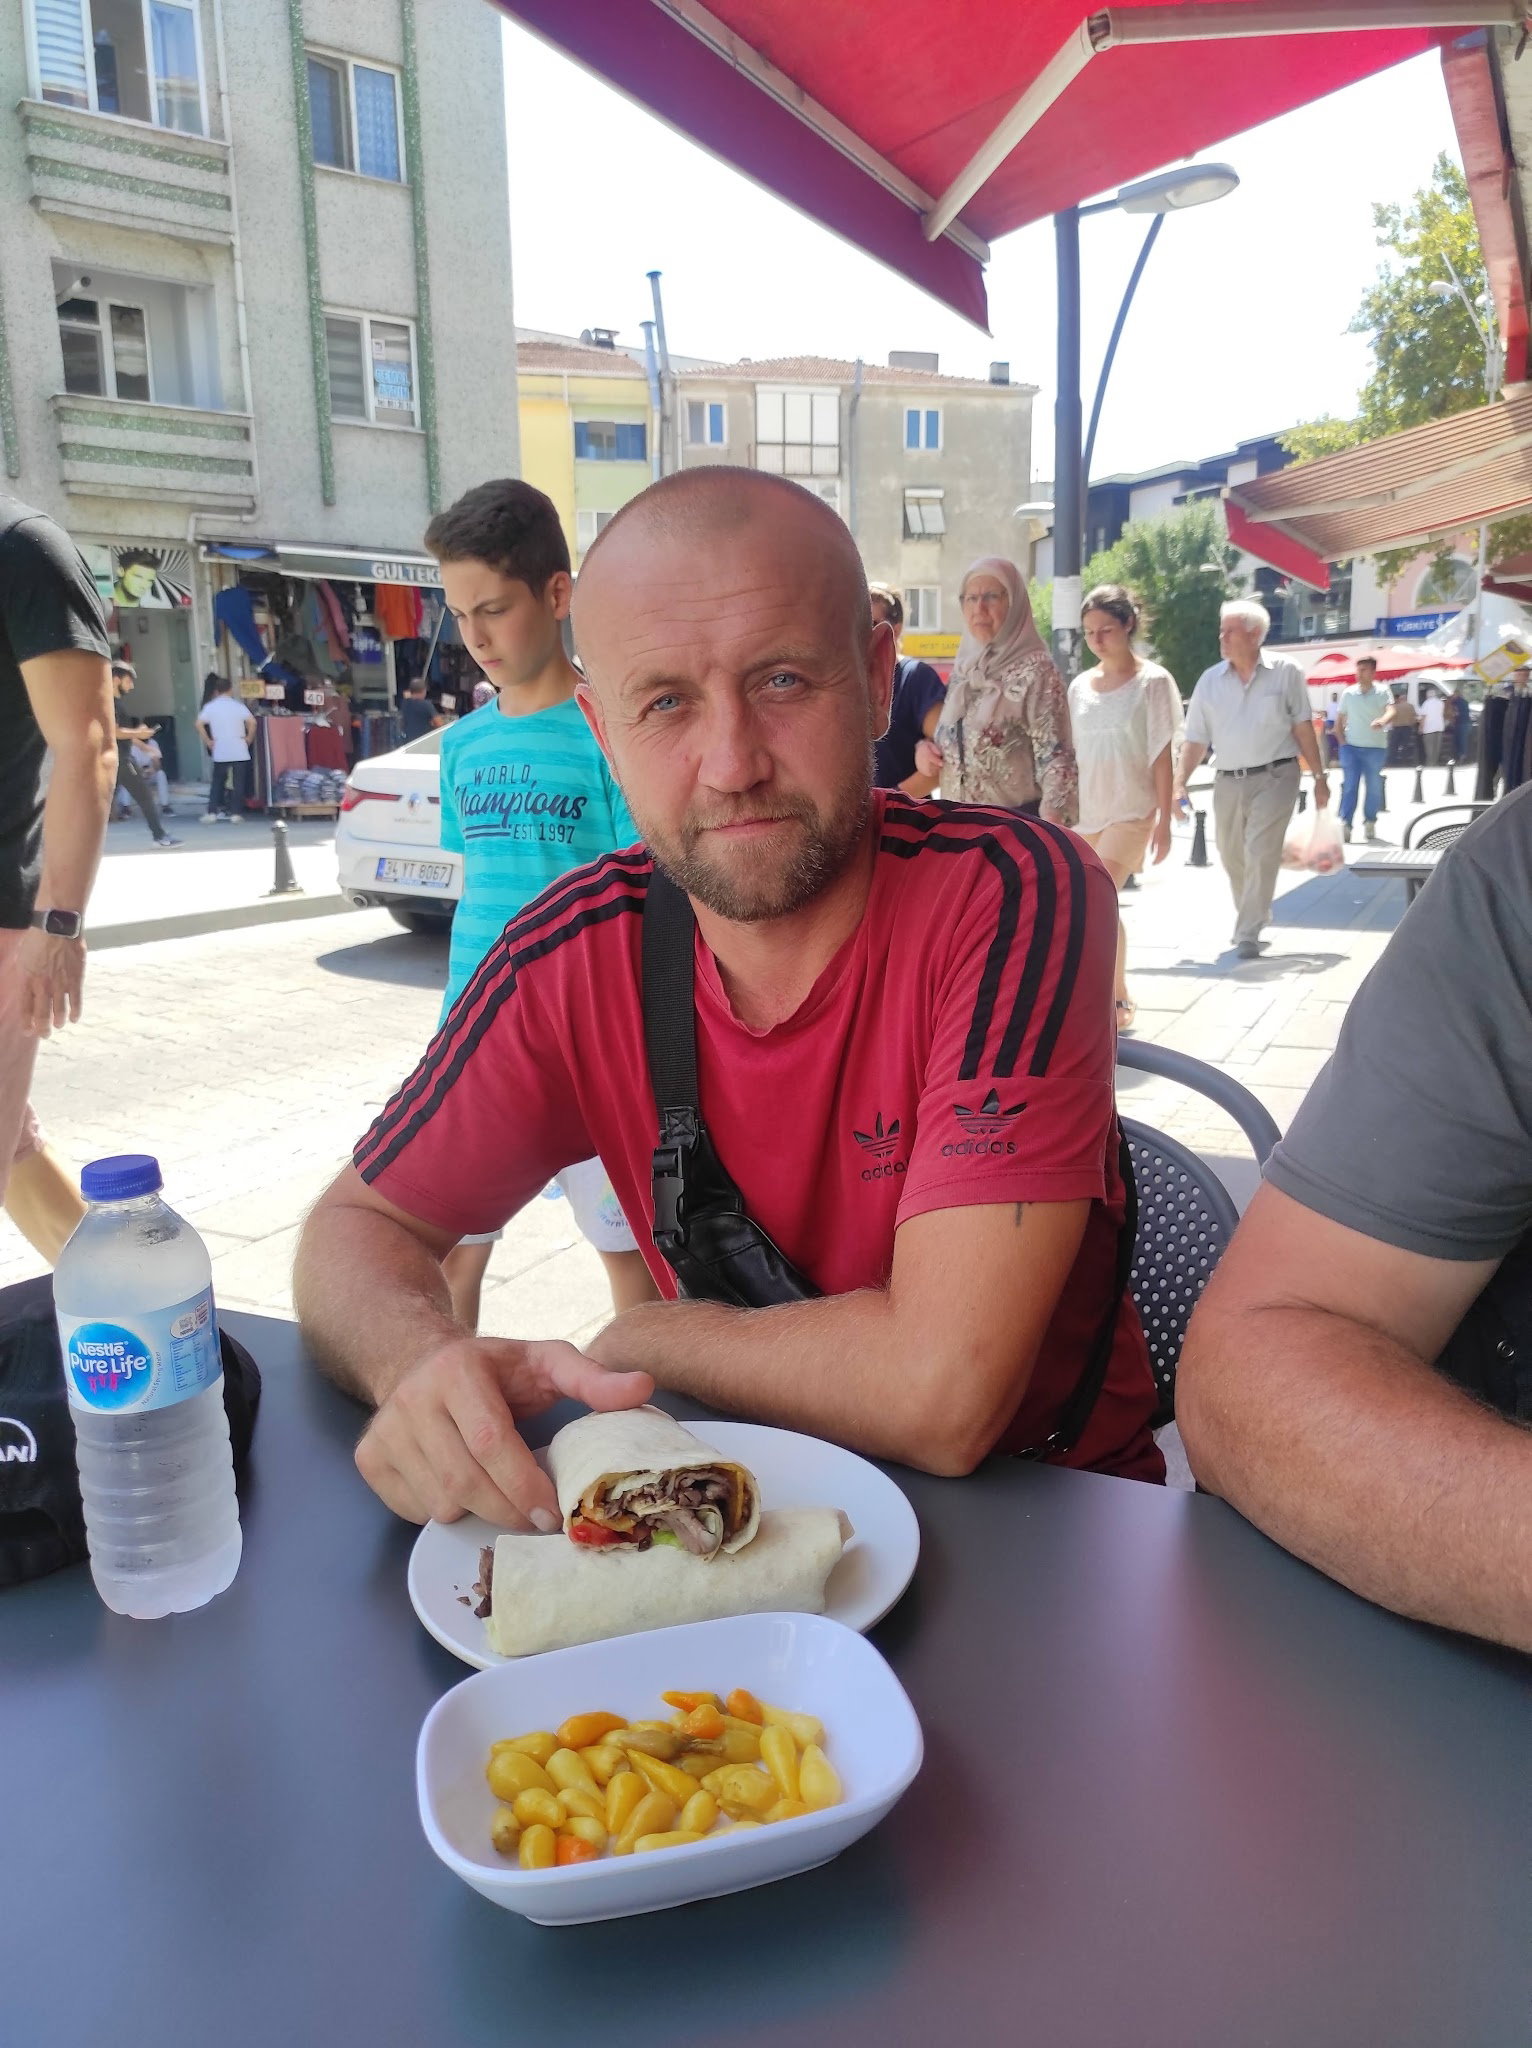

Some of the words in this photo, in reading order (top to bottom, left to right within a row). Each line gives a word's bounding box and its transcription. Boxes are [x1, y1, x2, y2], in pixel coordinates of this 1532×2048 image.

[306, 693, 323, 705] 40
[474, 764, 532, 786] WORLD
[402, 862, 415, 878] YT
[941, 1138, 1018, 1157] adidas
[861, 1158, 909, 1182] adida
[70, 1352, 108, 1374] Pure
[111, 1354, 148, 1380] Life
